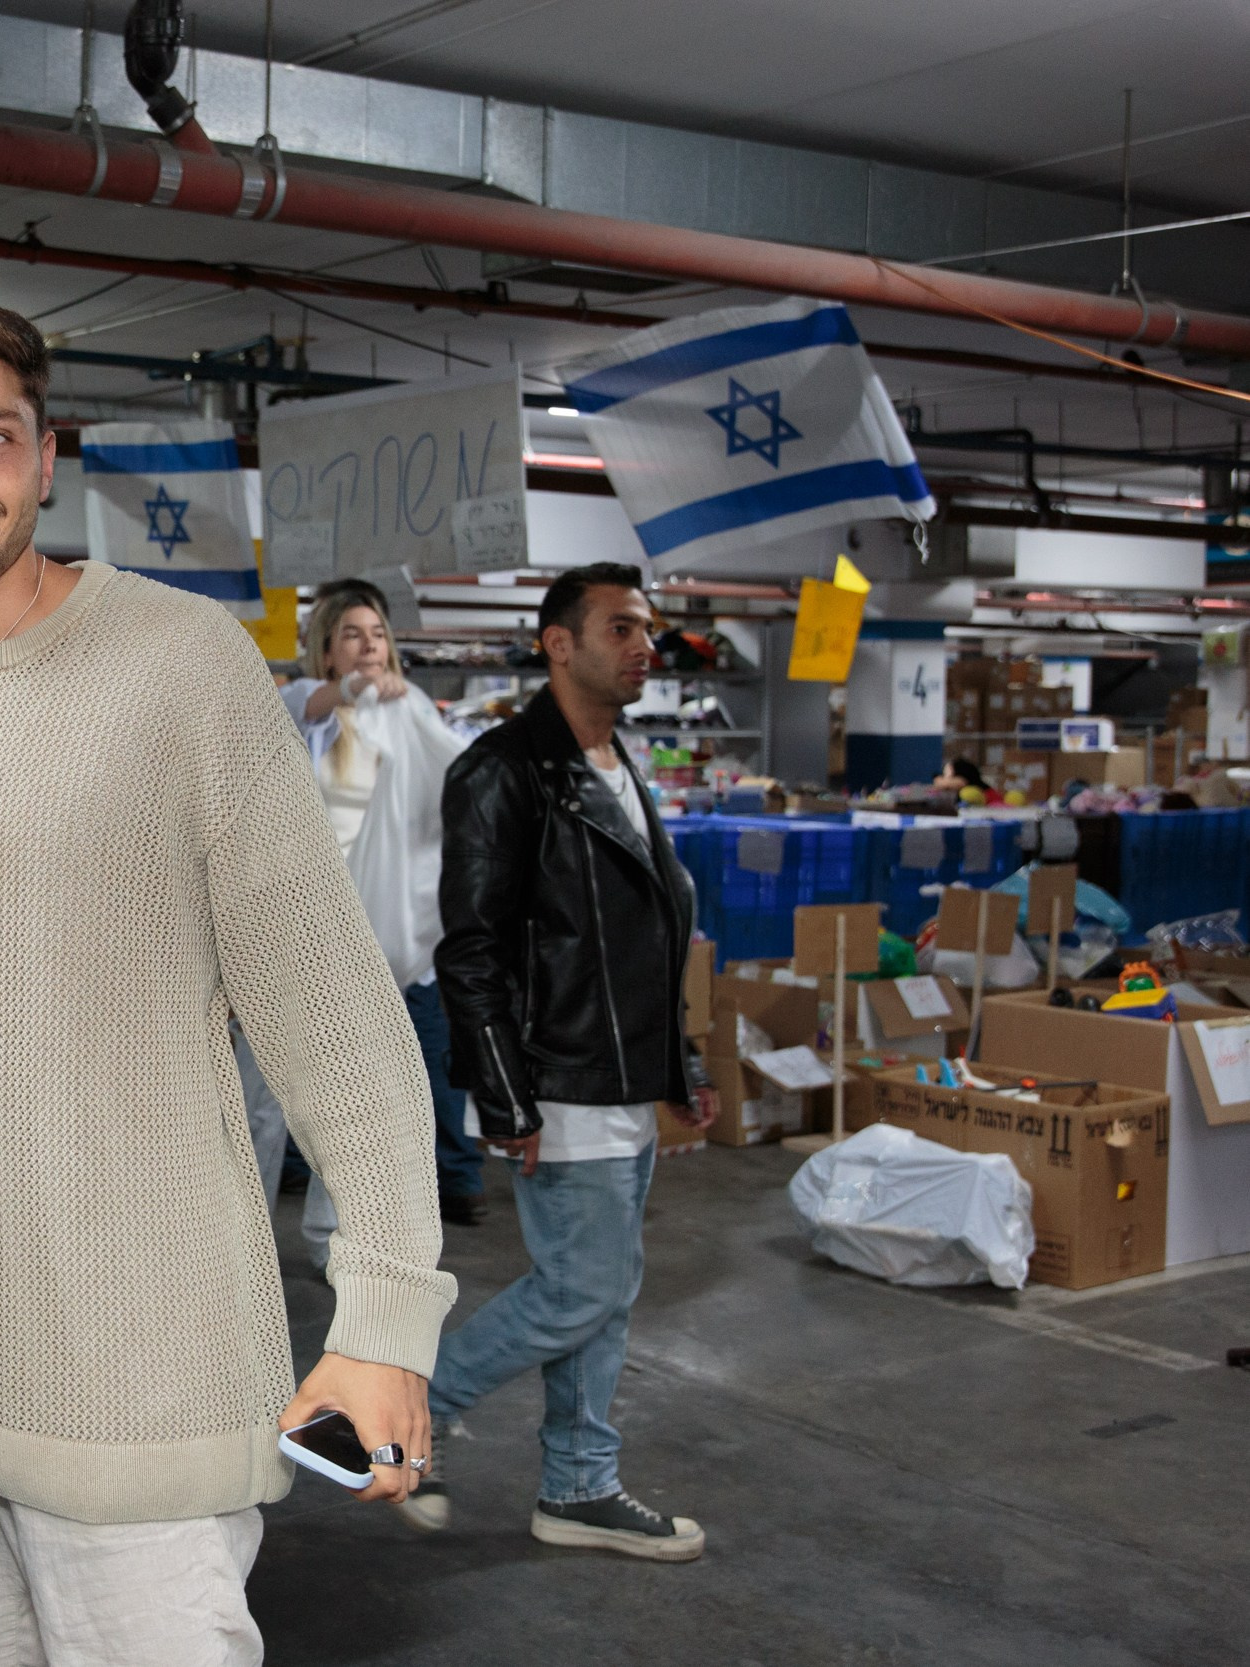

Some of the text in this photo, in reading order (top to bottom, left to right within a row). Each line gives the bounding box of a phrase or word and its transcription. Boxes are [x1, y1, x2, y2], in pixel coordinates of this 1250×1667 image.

[265, 421, 496, 570] משחקים
[924, 1093, 969, 1123] לישראל
[974, 1106, 1012, 1131] ההגנה
[1016, 1114, 1044, 1136] צבא
